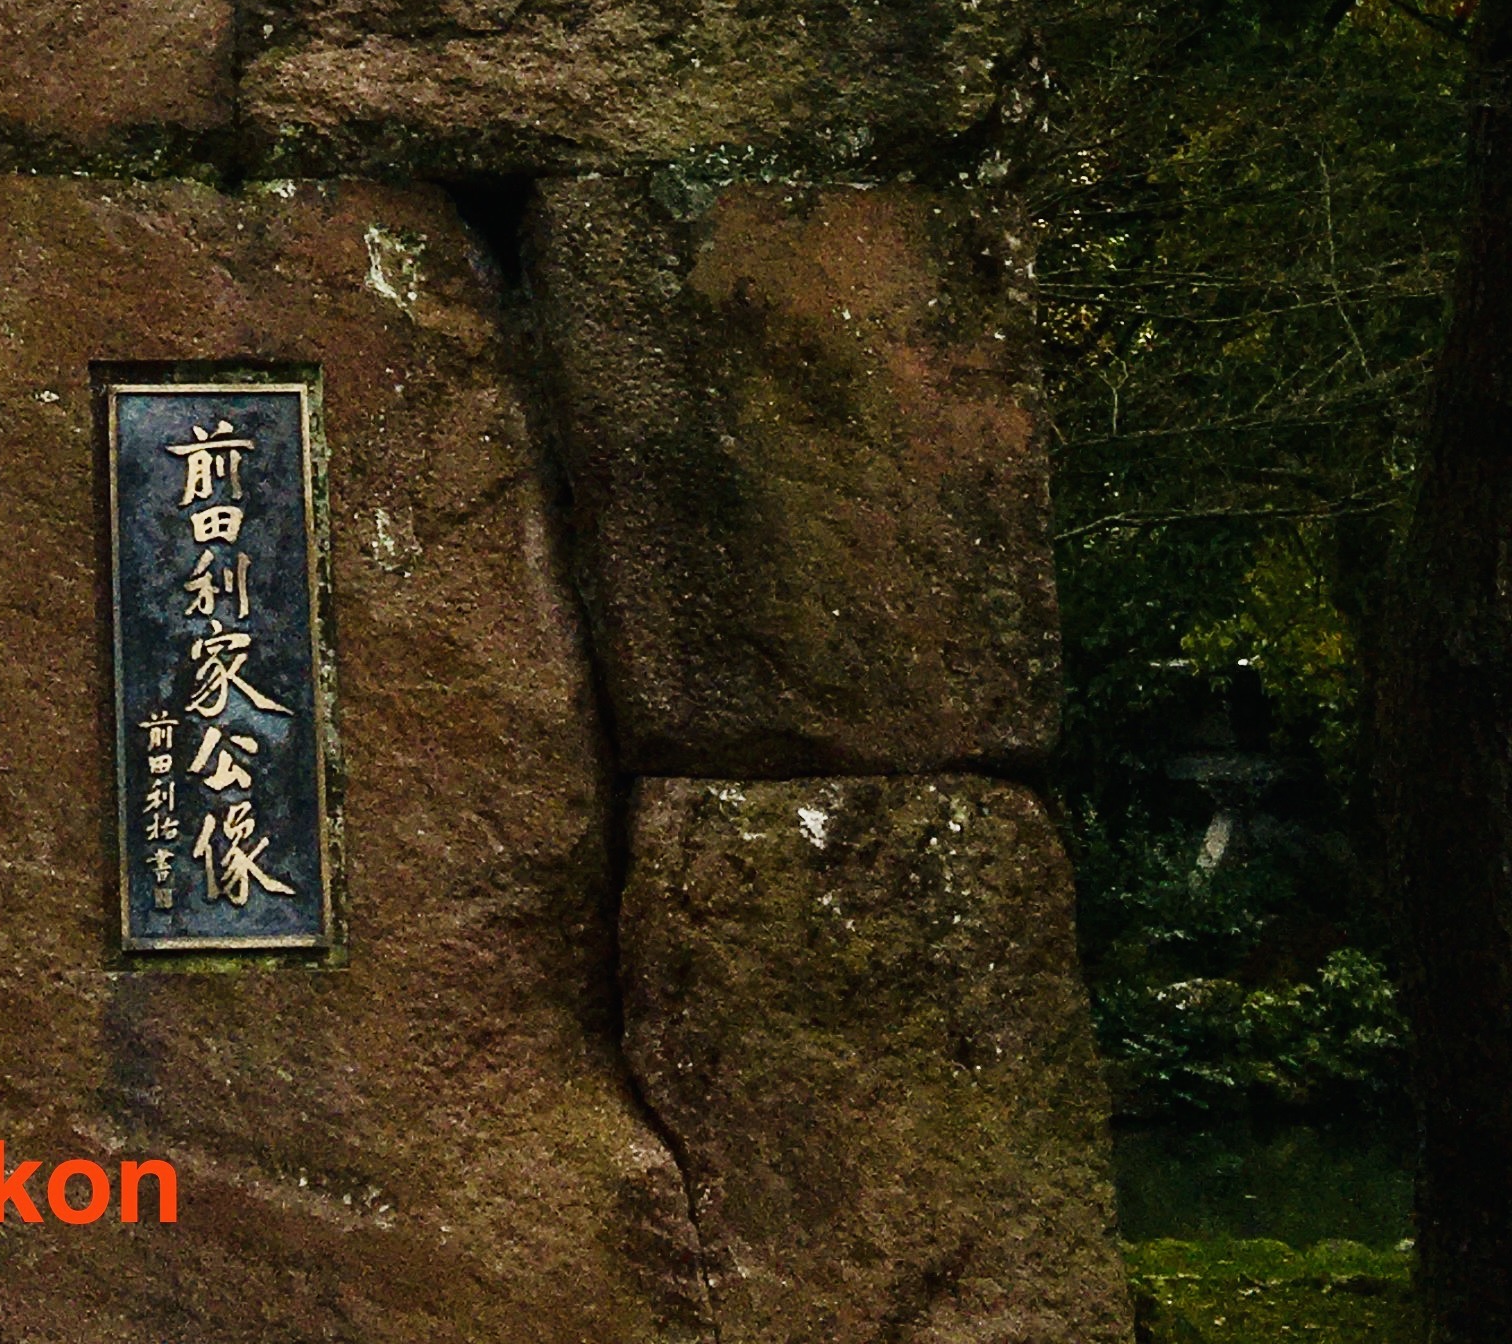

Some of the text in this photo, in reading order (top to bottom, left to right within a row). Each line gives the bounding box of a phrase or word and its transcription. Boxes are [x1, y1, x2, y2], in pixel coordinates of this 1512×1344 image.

[165, 419, 294, 906] 前田利家公像
